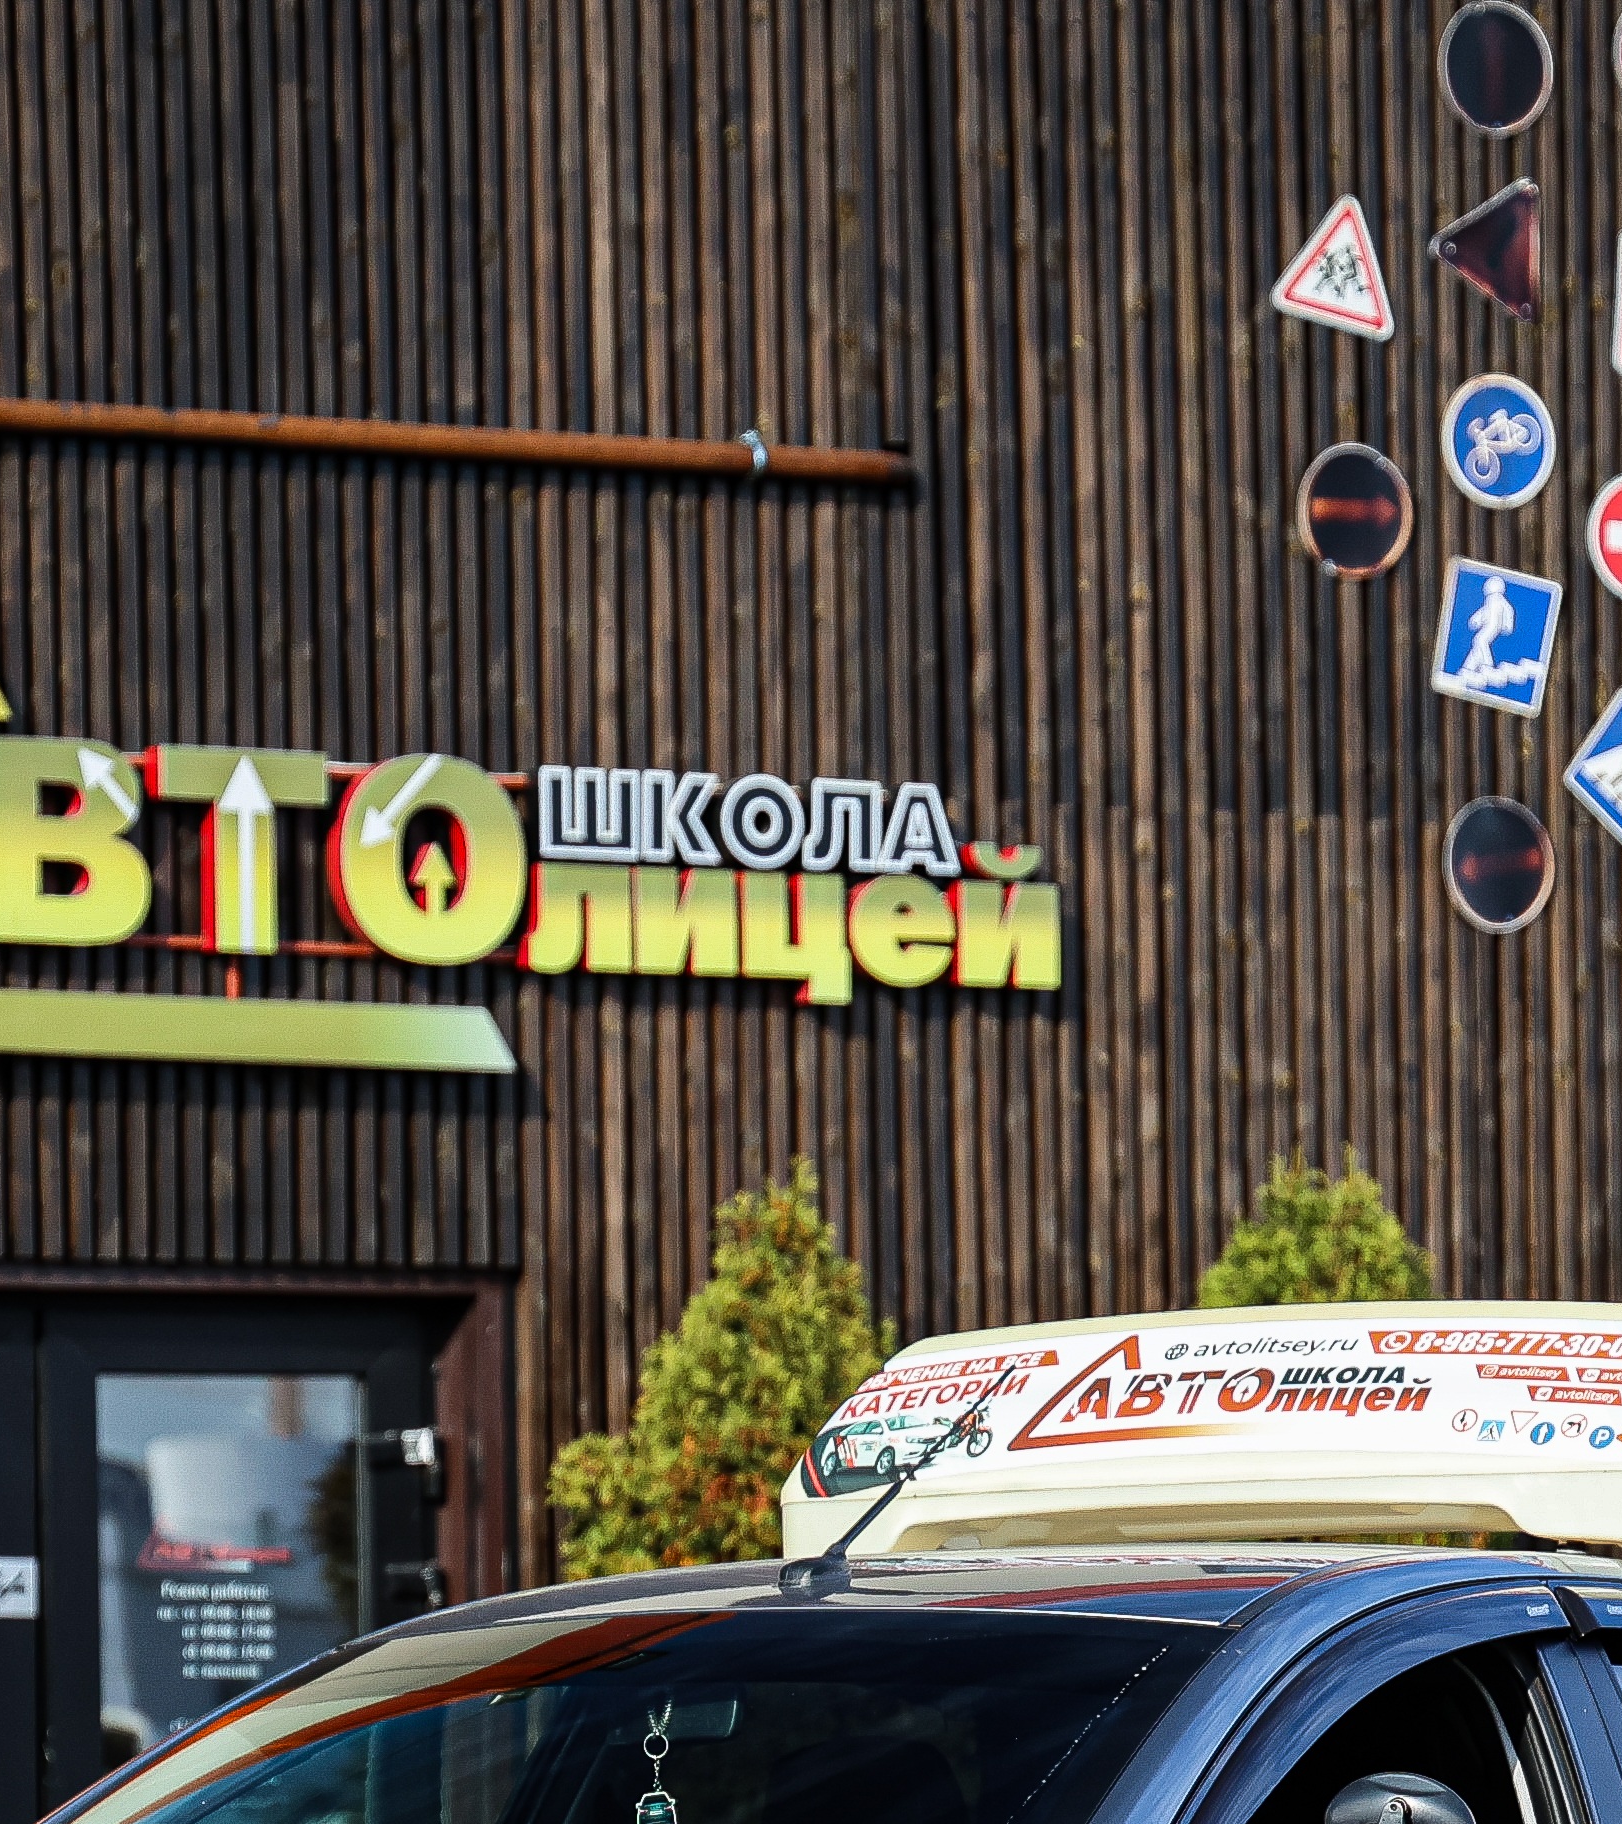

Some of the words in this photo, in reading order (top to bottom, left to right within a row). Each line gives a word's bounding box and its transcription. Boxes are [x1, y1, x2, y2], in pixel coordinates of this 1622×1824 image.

[538, 765, 962, 877] ШКОЛА
[519, 842, 1062, 1006] лицей
[1193, 1336, 1360, 1358] avtolitsey.ru
[965, 1359, 997, 1375] НА
[1000, 1352, 1045, 1370] ВСЕ
[1280, 1366, 1406, 1386] ШКОЛА
[1498, 1366, 1562, 1380] avtolitsey
[840, 1374, 1031, 1420] КАТЕГОРИИ
[1060, 1366, 1276, 1424] АВТО
[1265, 1377, 1432, 1417] лицей
[1553, 1388, 1619, 1404] avtolitsey
